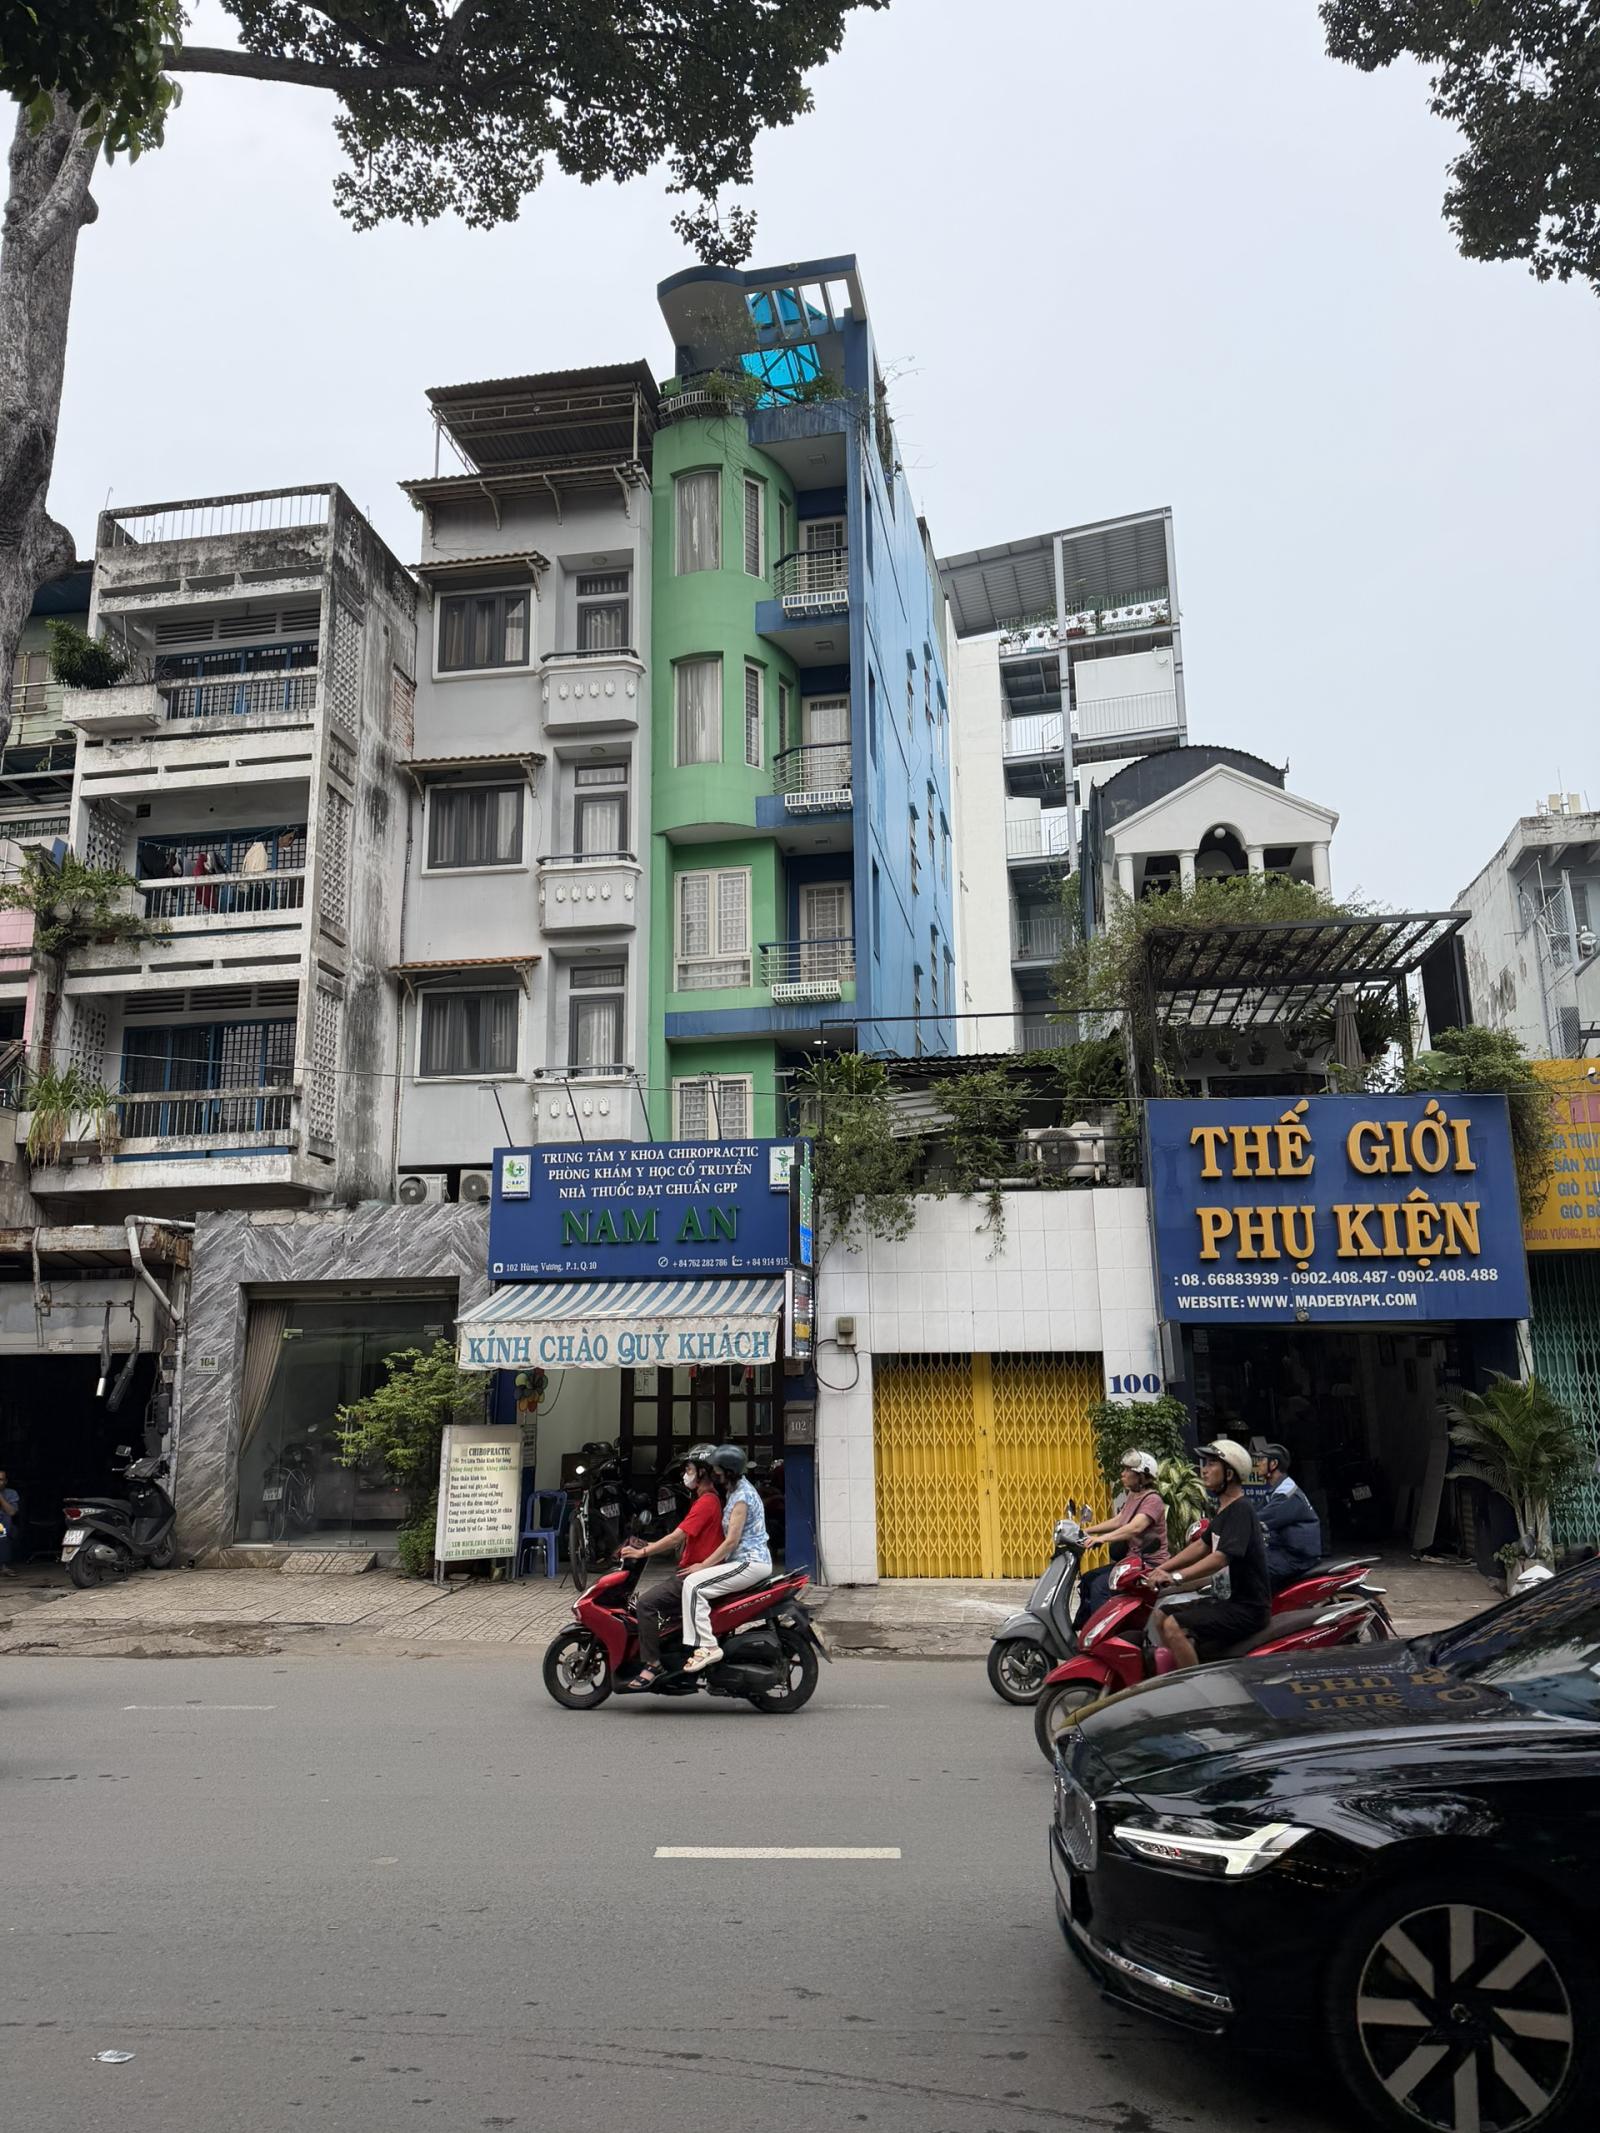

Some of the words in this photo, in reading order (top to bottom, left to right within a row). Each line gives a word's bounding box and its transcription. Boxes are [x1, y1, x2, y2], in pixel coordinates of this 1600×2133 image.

[1190, 1099, 1315, 1178] THẾ
[1347, 1098, 1476, 1174] GIỚI
[542, 1153, 583, 1164] TRUNG
[587, 1149, 614, 1162] TÂM
[618, 1151, 627, 1161] Y
[631, 1149, 664, 1160] KHOA
[668, 1146, 759, 1159] CHIROPRACTIC
[548, 1166, 590, 1180] PHÒNG
[594, 1164, 632, 1178] KHÁM
[636, 1167, 645, 1178] Y
[649, 1165, 675, 1179] HỌC
[678, 1160, 695, 1176] CỔ
[699, 1159, 752, 1176] TRUYỀN
[560, 1184, 586, 1198] NHÀ
[591, 1181, 634, 1197] THUỐC
[637, 1184, 662, 1196] ĐẠT
[666, 1179, 710, 1194] CHUẨN
[714, 1183, 738, 1194] GPP
[560, 1207, 660, 1244] NAM
[676, 1205, 740, 1241] AN
[1195, 1205, 1317, 1270] PHỤ
[1333, 1187, 1481, 1268] KIỆN
[506, 1264, 518, 1272] 102
[520, 1263, 538, 1273] Hùng
[702, 1259, 714, 1267] 282
[715, 1258, 728, 1267] 786
[1291, 1270, 1388, 1284] 0902.408.487
[1398, 1268, 1498, 1283] 0902.408.488
[468, 1329, 532, 1363] KÍNH
[540, 1326, 608, 1362] CHÀO
[678, 1324, 770, 1360] KHÁCH
[1109, 1373, 1161, 1394] 100
[791, 1421, 806, 1431] 102
